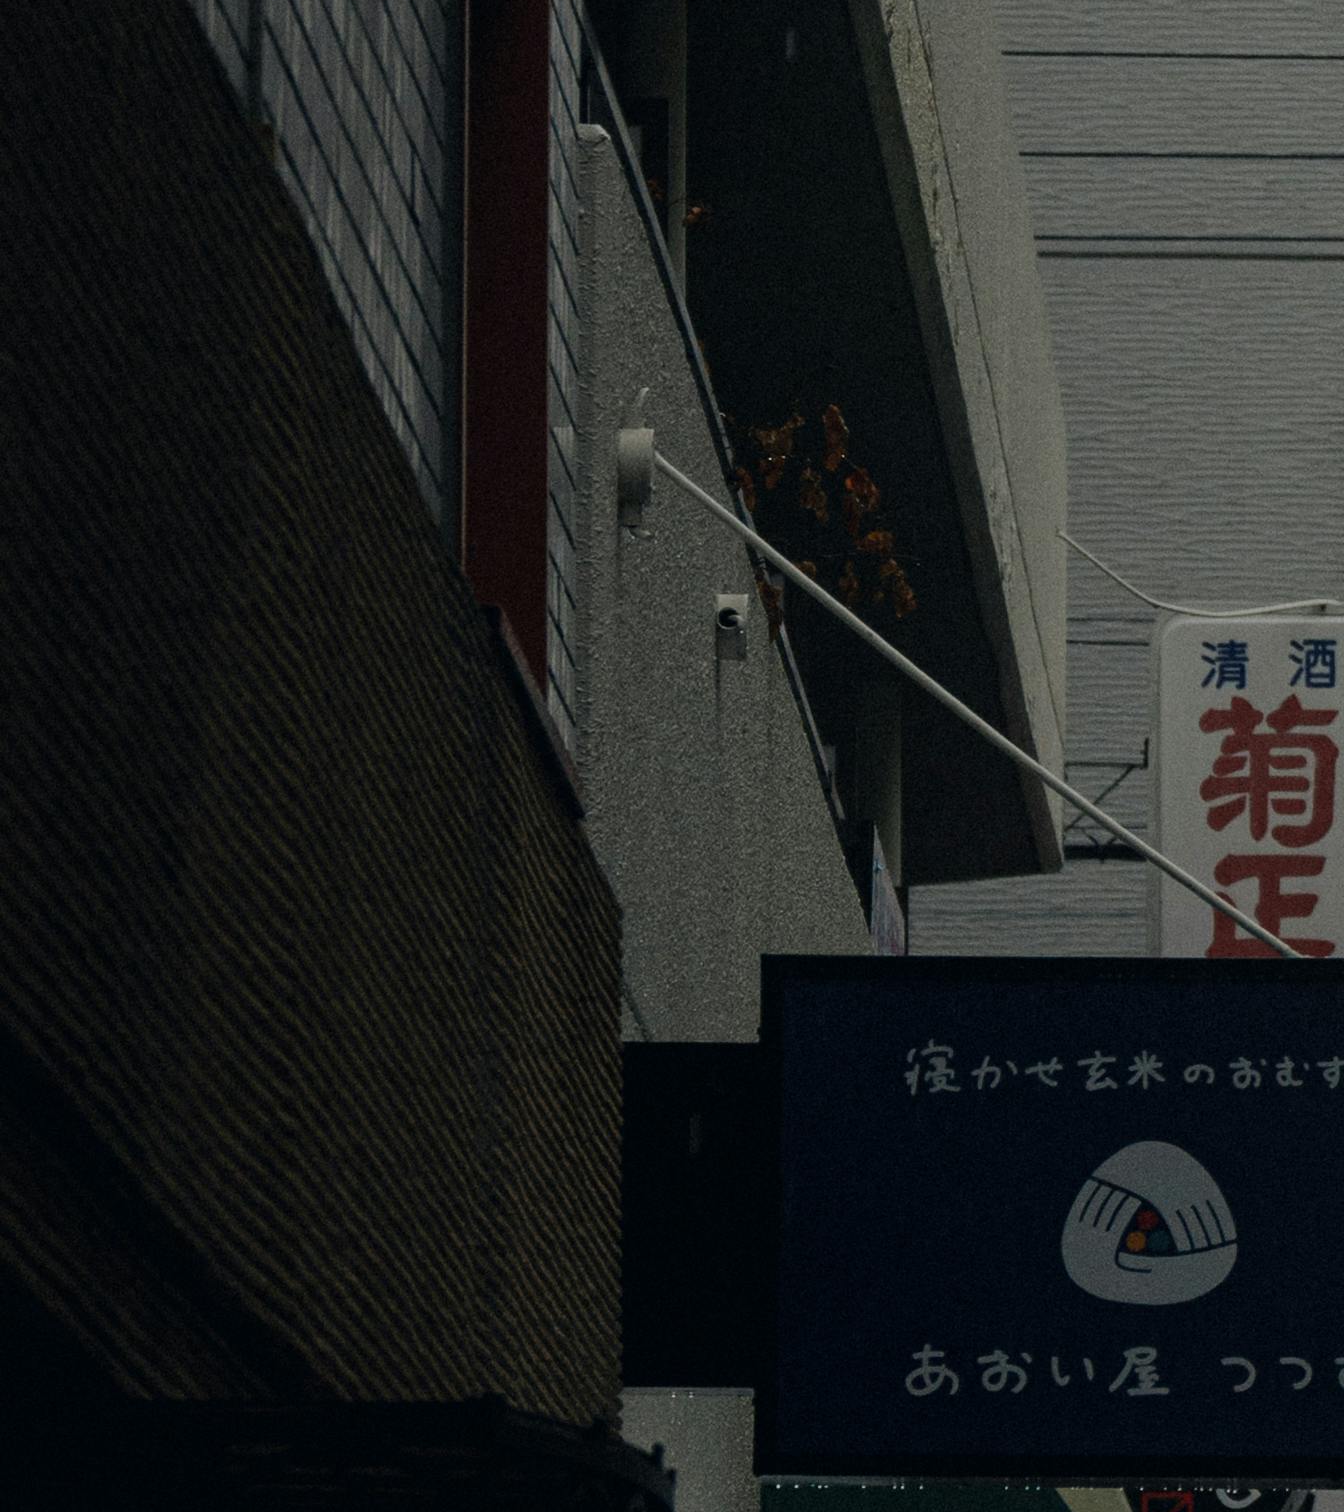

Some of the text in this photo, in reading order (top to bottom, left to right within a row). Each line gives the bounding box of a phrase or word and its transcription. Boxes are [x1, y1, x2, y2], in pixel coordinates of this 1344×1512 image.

[1201, 639, 1338, 690] 清酒
[904, 1344, 1171, 1397] あおい屋
